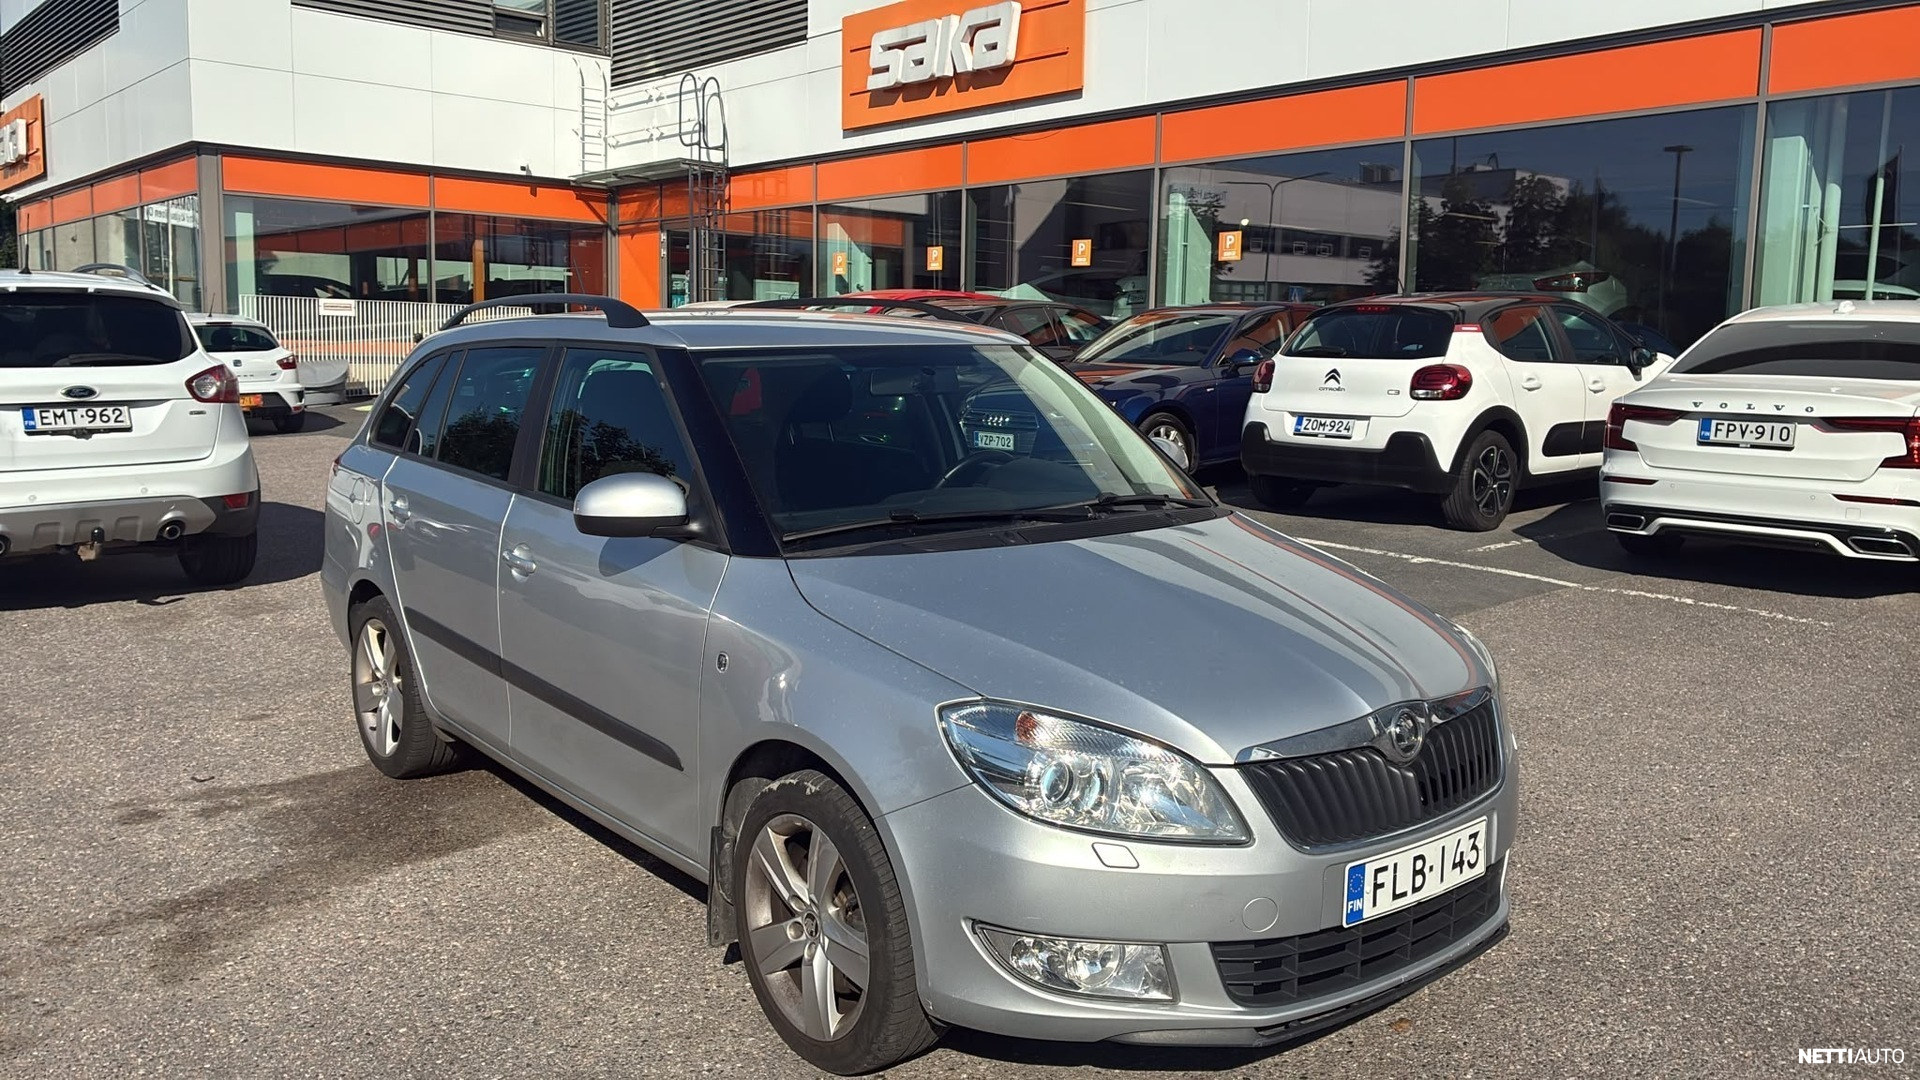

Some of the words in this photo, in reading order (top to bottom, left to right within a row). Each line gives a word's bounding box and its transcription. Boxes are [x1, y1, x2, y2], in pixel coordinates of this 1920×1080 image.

[1078, 242, 1086, 256] P
[1226, 235, 1235, 249] P
[932, 249, 939, 261] P
[1692, 401, 1815, 412] VOLVO
[1347, 898, 1363, 914] FIN
